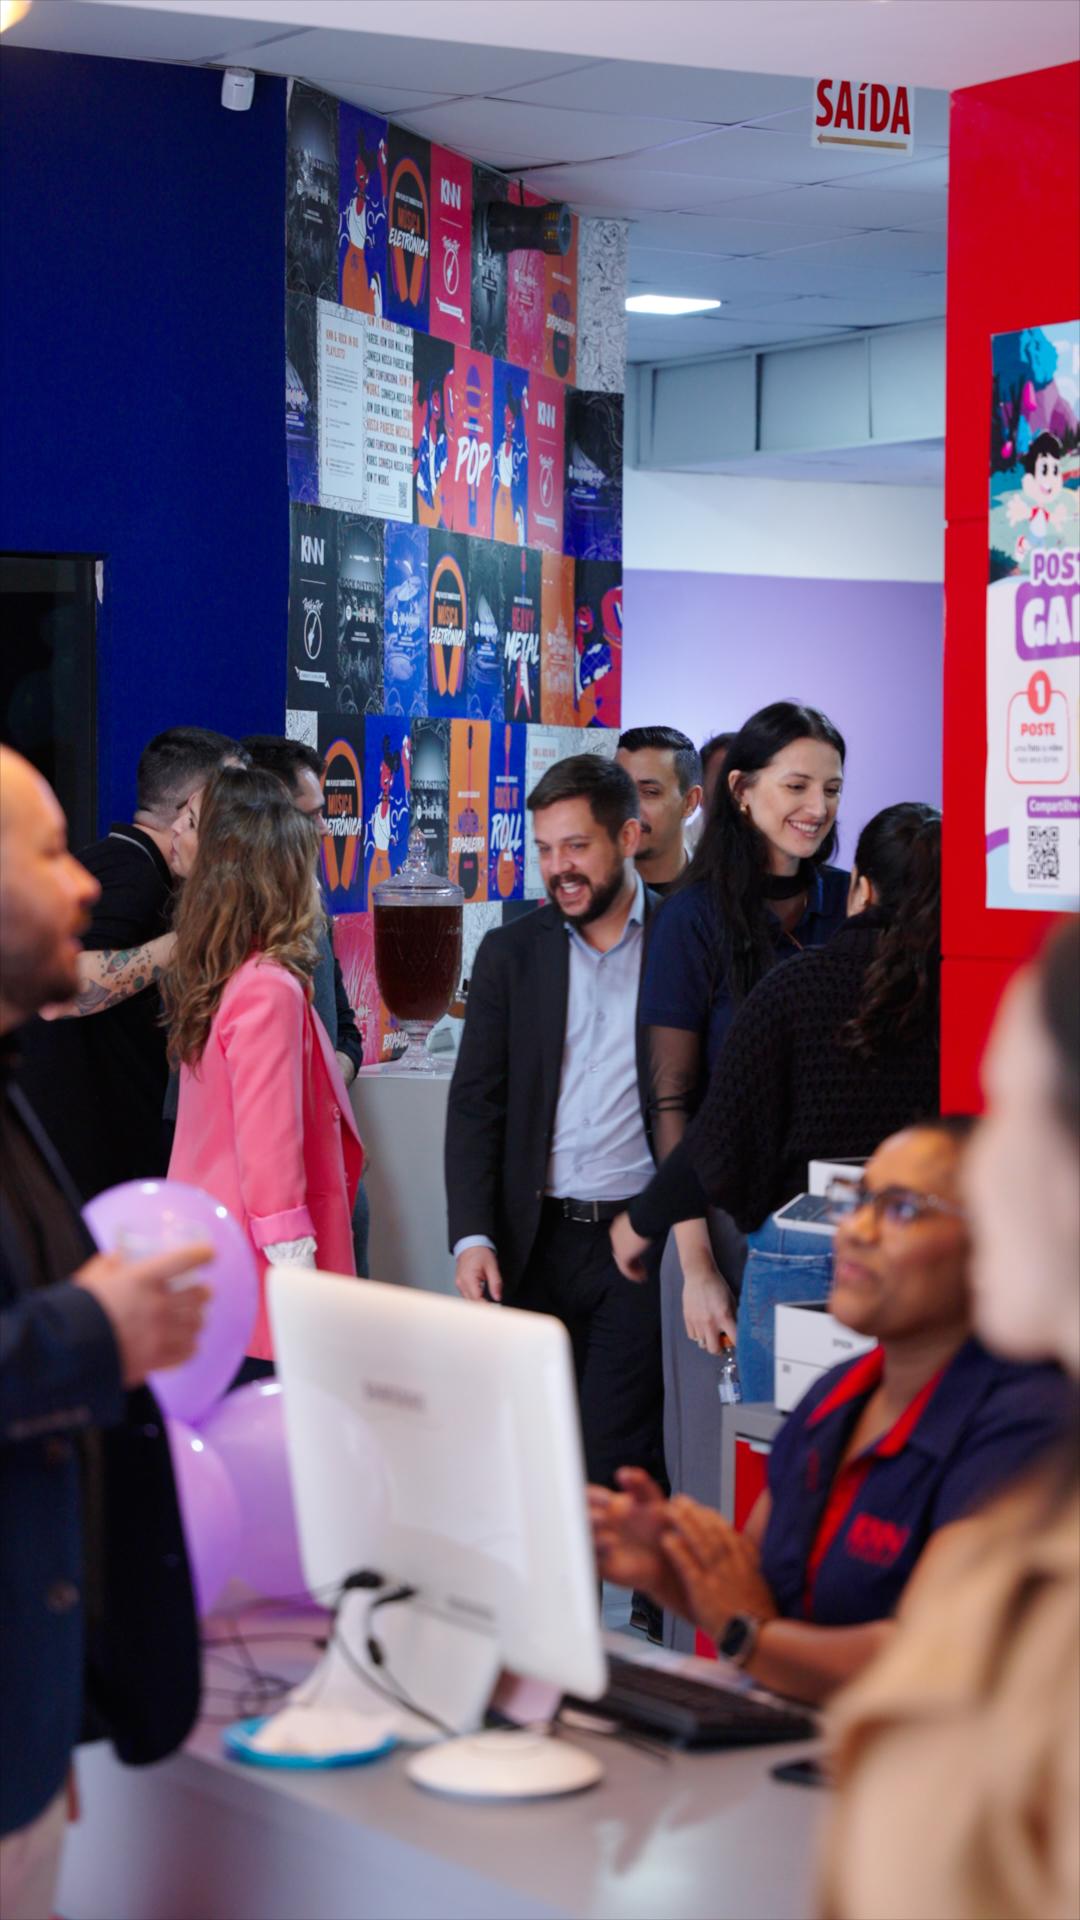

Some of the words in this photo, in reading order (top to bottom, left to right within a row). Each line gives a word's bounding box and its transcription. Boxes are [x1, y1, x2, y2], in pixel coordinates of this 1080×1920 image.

[815, 78, 911, 135] SAÍDA
[440, 178, 462, 210] KNN
[537, 400, 556, 429] KNN
[454, 436, 492, 488] POP
[300, 535, 325, 566] KNN
[437, 602, 459, 626] MÚSICA
[504, 631, 540, 668] METAL
[1035, 680, 1046, 707] 1
[1020, 722, 1056, 736] POSTE
[327, 788, 353, 816] MÚSICA
[324, 811, 362, 837] ETRÔNICA
[490, 813, 522, 853] ROLL
